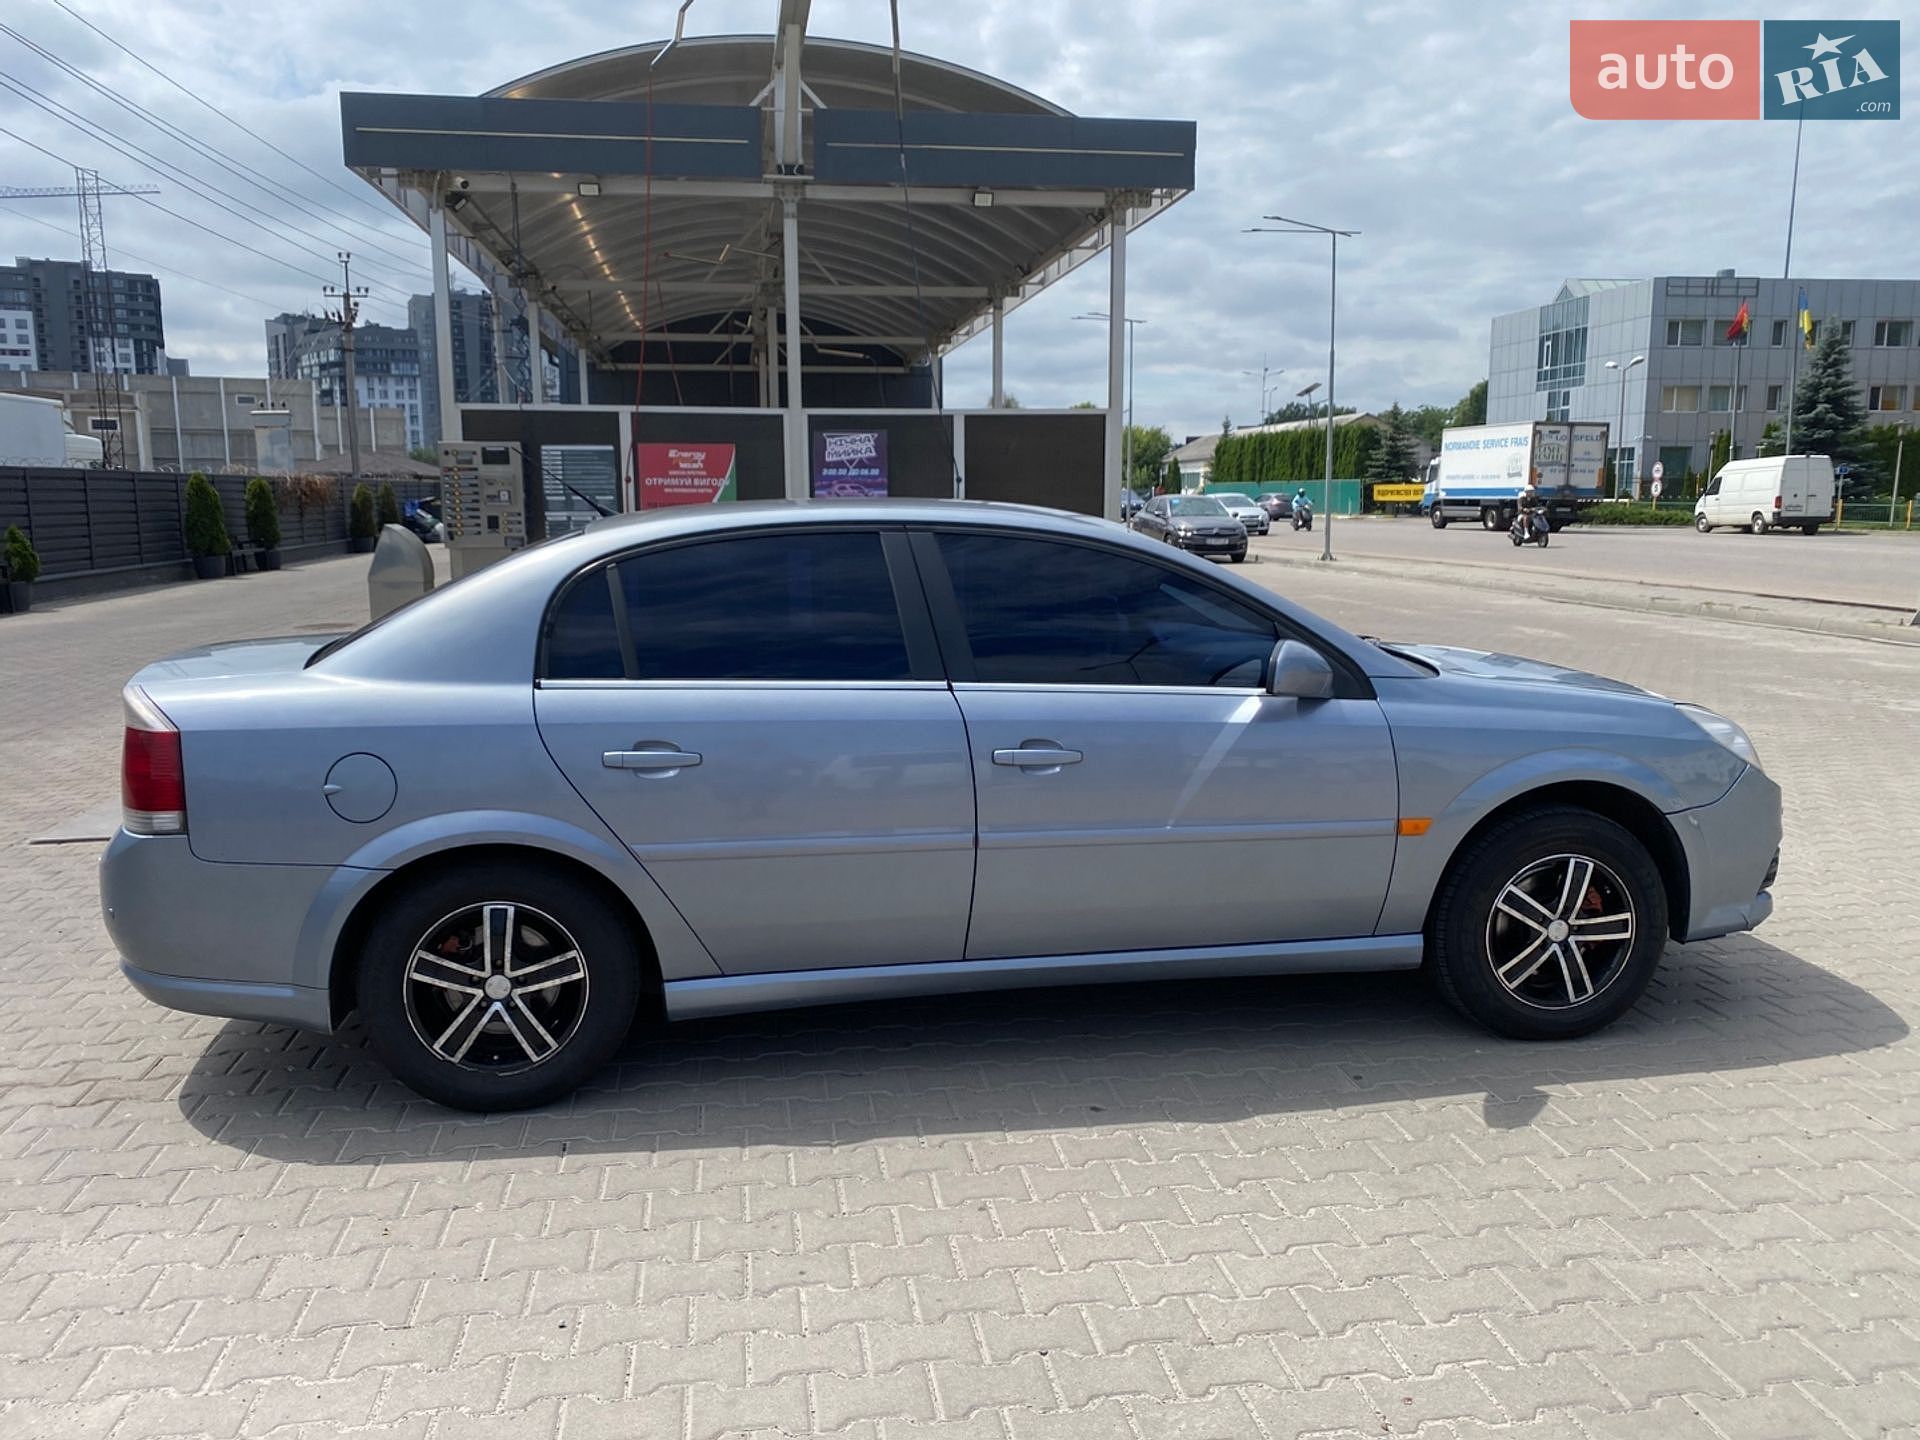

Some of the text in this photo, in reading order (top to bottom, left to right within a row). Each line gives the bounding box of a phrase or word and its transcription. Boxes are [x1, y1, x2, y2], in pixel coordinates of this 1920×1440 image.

[1445, 436, 1529, 451] NORMANDIE SERVICE FRAIS
[667, 448, 706, 460] Energy
[827, 446, 874, 460] МИЙКА
[645, 476, 692, 486] ОТРИМУЙ
